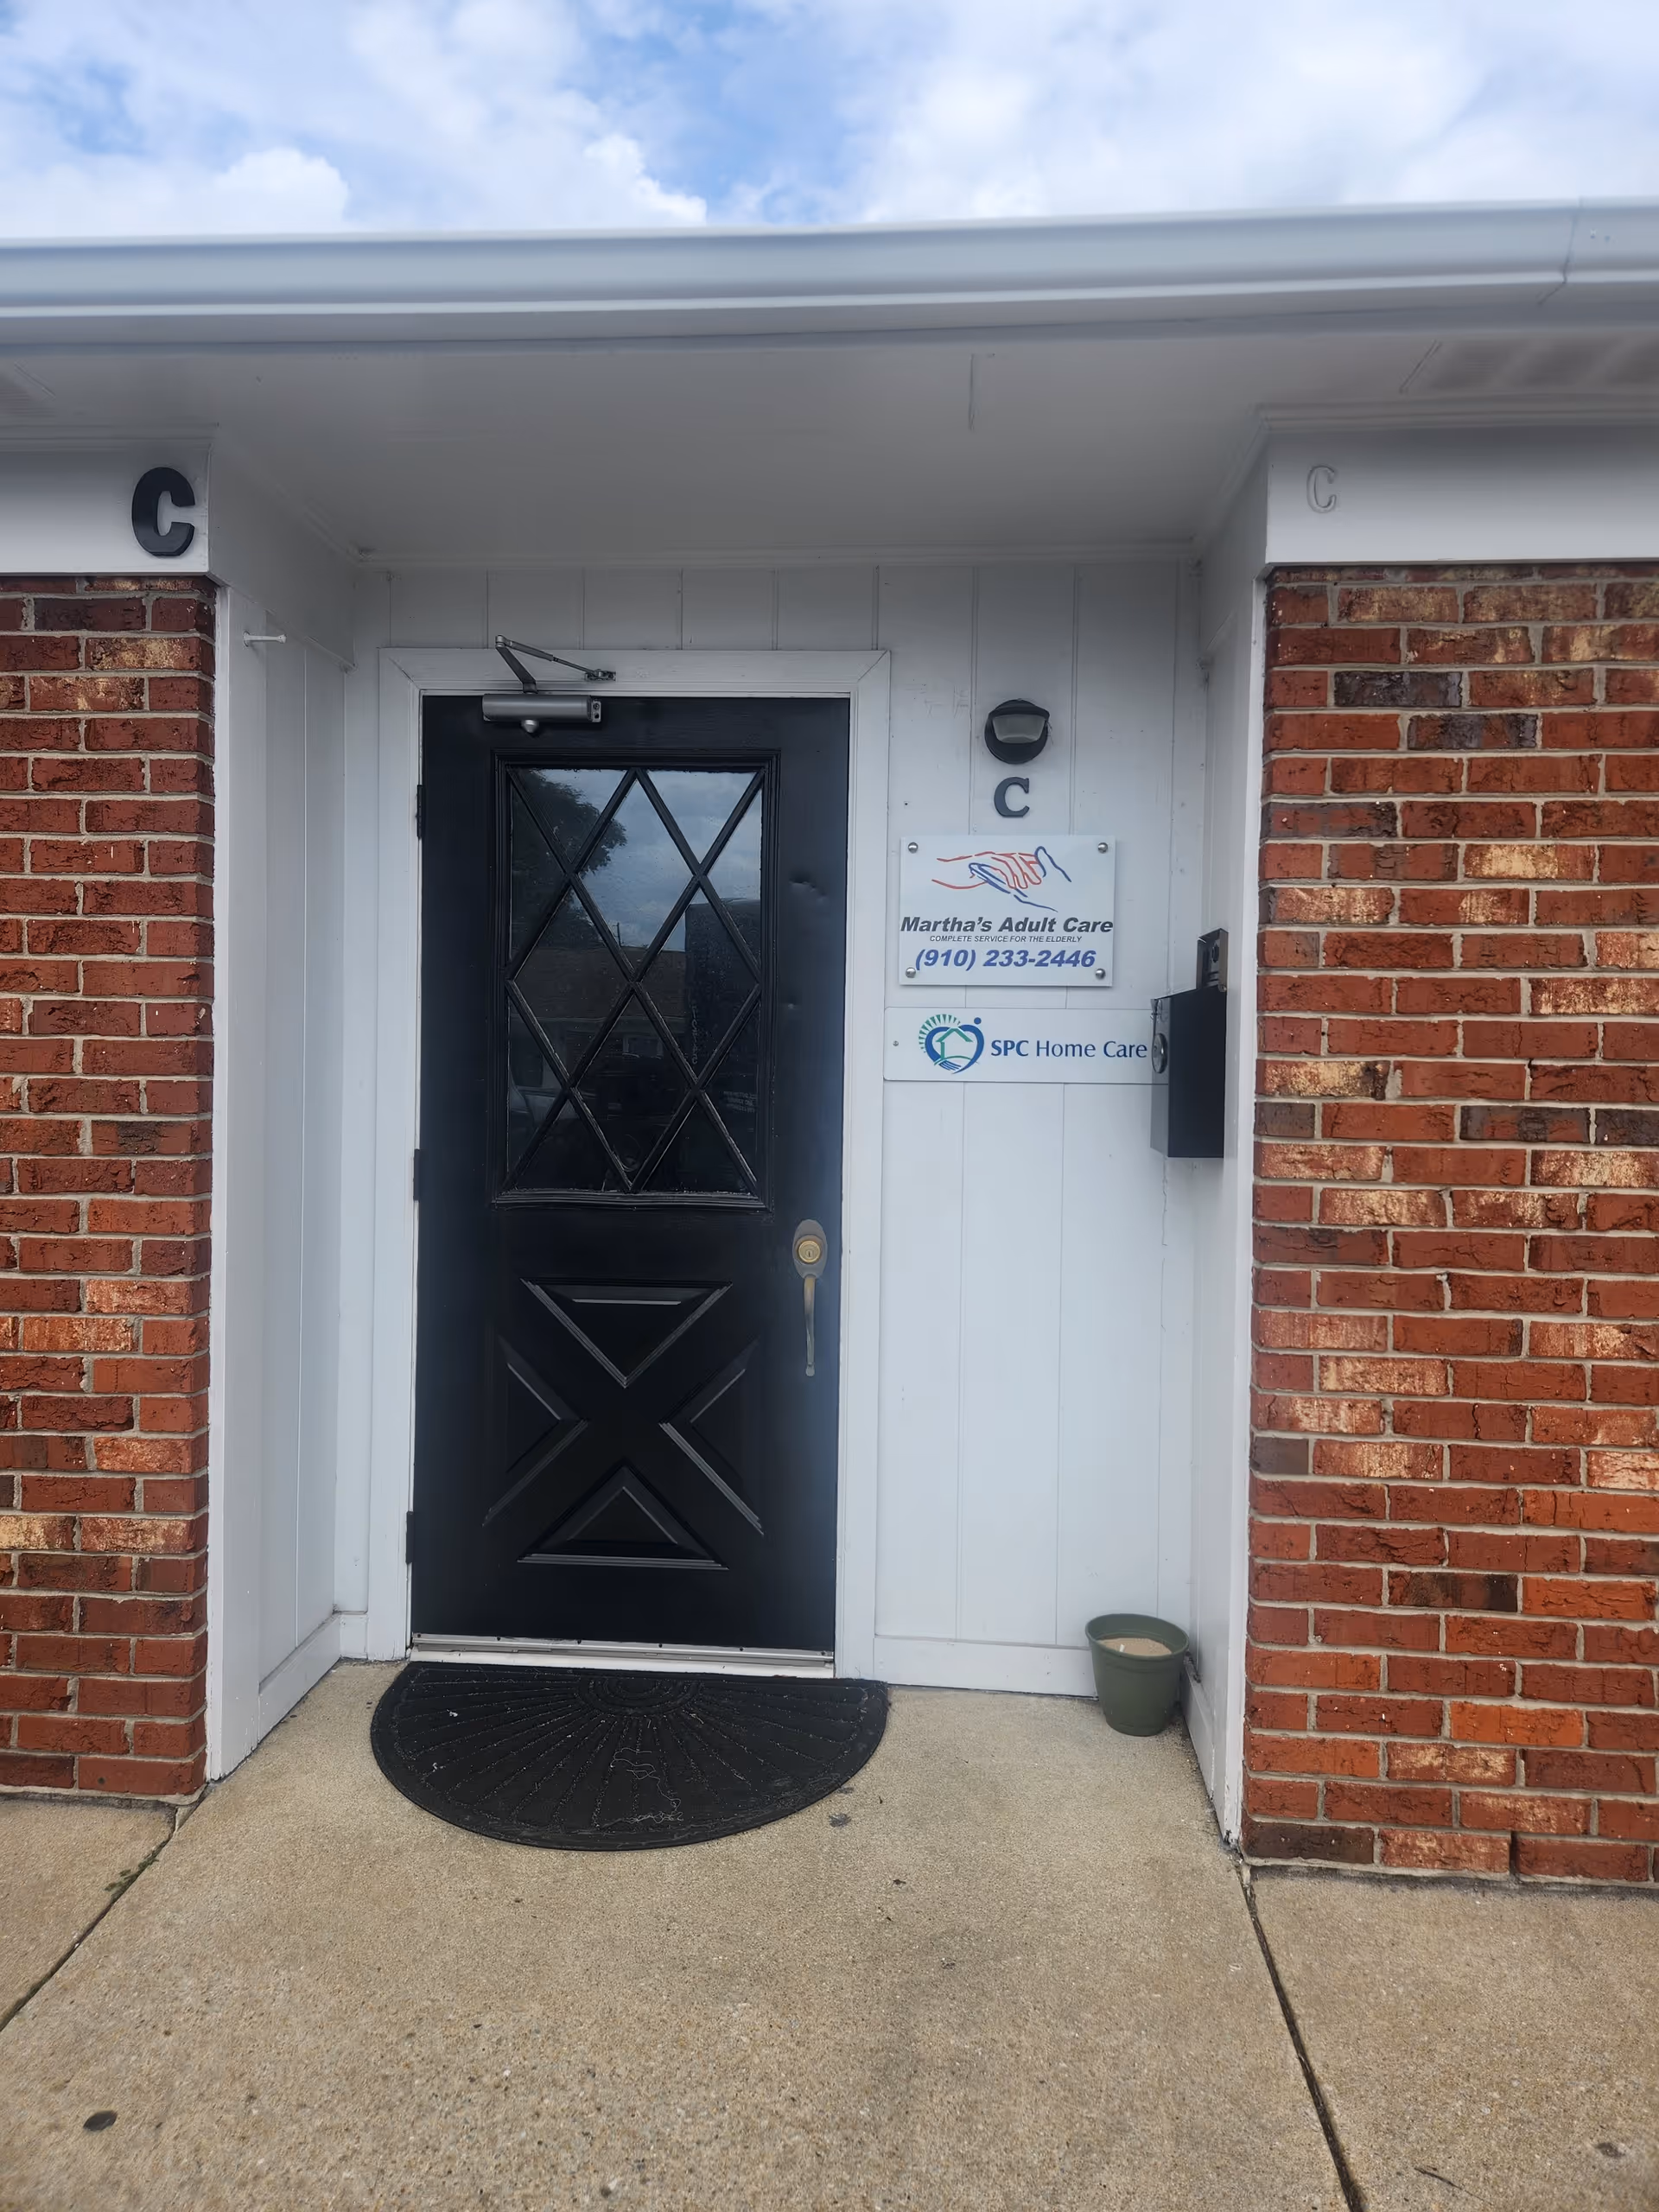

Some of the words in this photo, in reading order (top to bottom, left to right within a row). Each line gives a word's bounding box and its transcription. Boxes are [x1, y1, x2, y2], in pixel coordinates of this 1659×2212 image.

[1306, 465, 1338, 514] C
[131, 467, 196, 557] C
[993, 777, 1030, 818] C
[900, 917, 992, 933] Martha's
[998, 917, 1057, 933] Adult
[1063, 917, 1114, 934] Care
[915, 949, 976, 971] (910)
[982, 950, 1096, 968] 233-2446
[990, 1039, 1029, 1057] SPC
[1036, 1040, 1096, 1058] Home
[1103, 1041, 1147, 1058] Care
